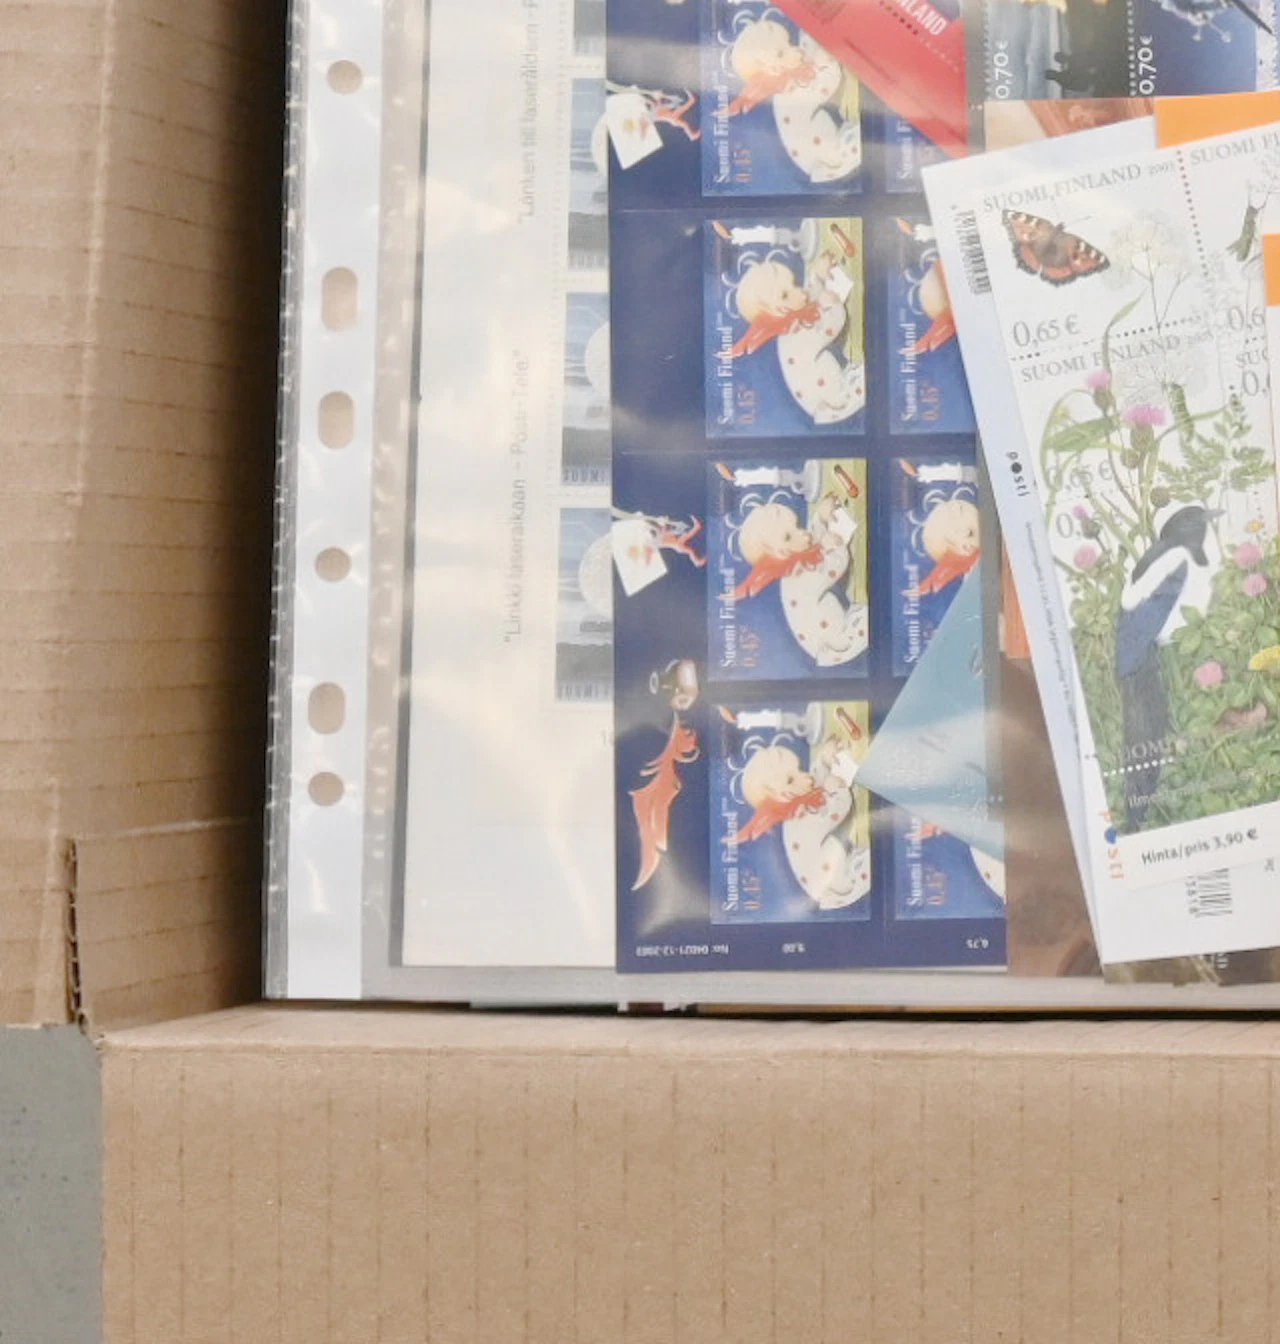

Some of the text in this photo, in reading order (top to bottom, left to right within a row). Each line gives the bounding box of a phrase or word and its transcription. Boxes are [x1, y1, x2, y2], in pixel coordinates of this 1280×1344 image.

[713, 140, 730, 183] Suomi
[1190, 140, 1257, 166] SUOMI
[983, 186, 1048, 213] SUOMI
[1054, 163, 1142, 198] FINLAND
[1021, 358, 1087, 383] SUOMI
[717, 382, 734, 424] Suomi
[901, 380, 917, 421] Suomi
[719, 623, 736, 667] Suomi
[903, 620, 920, 663] Suomi
[1142, 828, 1259, 866] Hinta/pris 3,90 €
[722, 866, 739, 911] Suomi
[906, 863, 923, 906] Suomi
